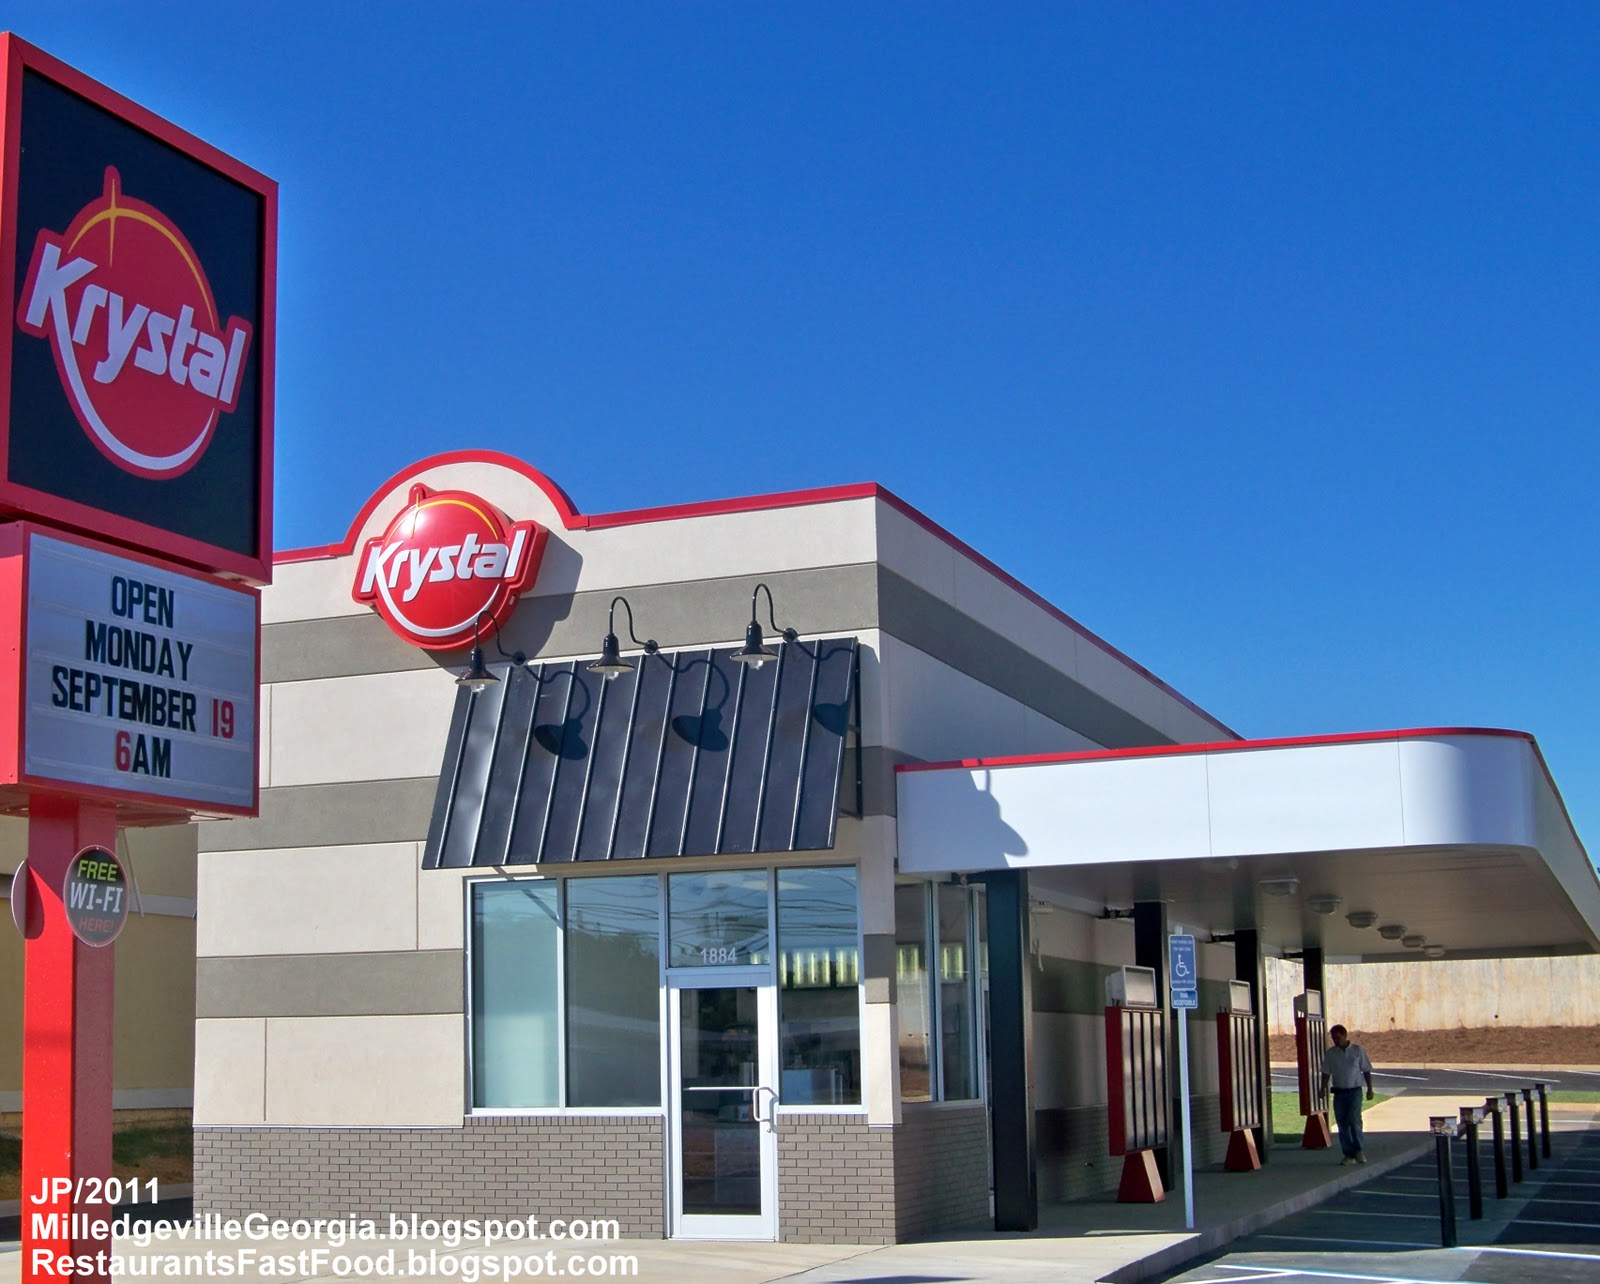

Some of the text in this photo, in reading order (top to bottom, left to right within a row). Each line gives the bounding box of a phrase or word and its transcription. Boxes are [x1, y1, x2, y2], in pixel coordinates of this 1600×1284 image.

[26, 242, 246, 404] Krystal
[360, 529, 527, 602] Krystal
[112, 576, 174, 628] OPEN
[85, 620, 193, 682] MONDAY
[52, 665, 234, 739] SEPTEMBER 19
[115, 730, 171, 778] 6AM
[77, 860, 118, 882] FREE
[70, 882, 123, 913] WI-FI
[78, 915, 115, 934] HERE!
[700, 947, 738, 964] 1884
